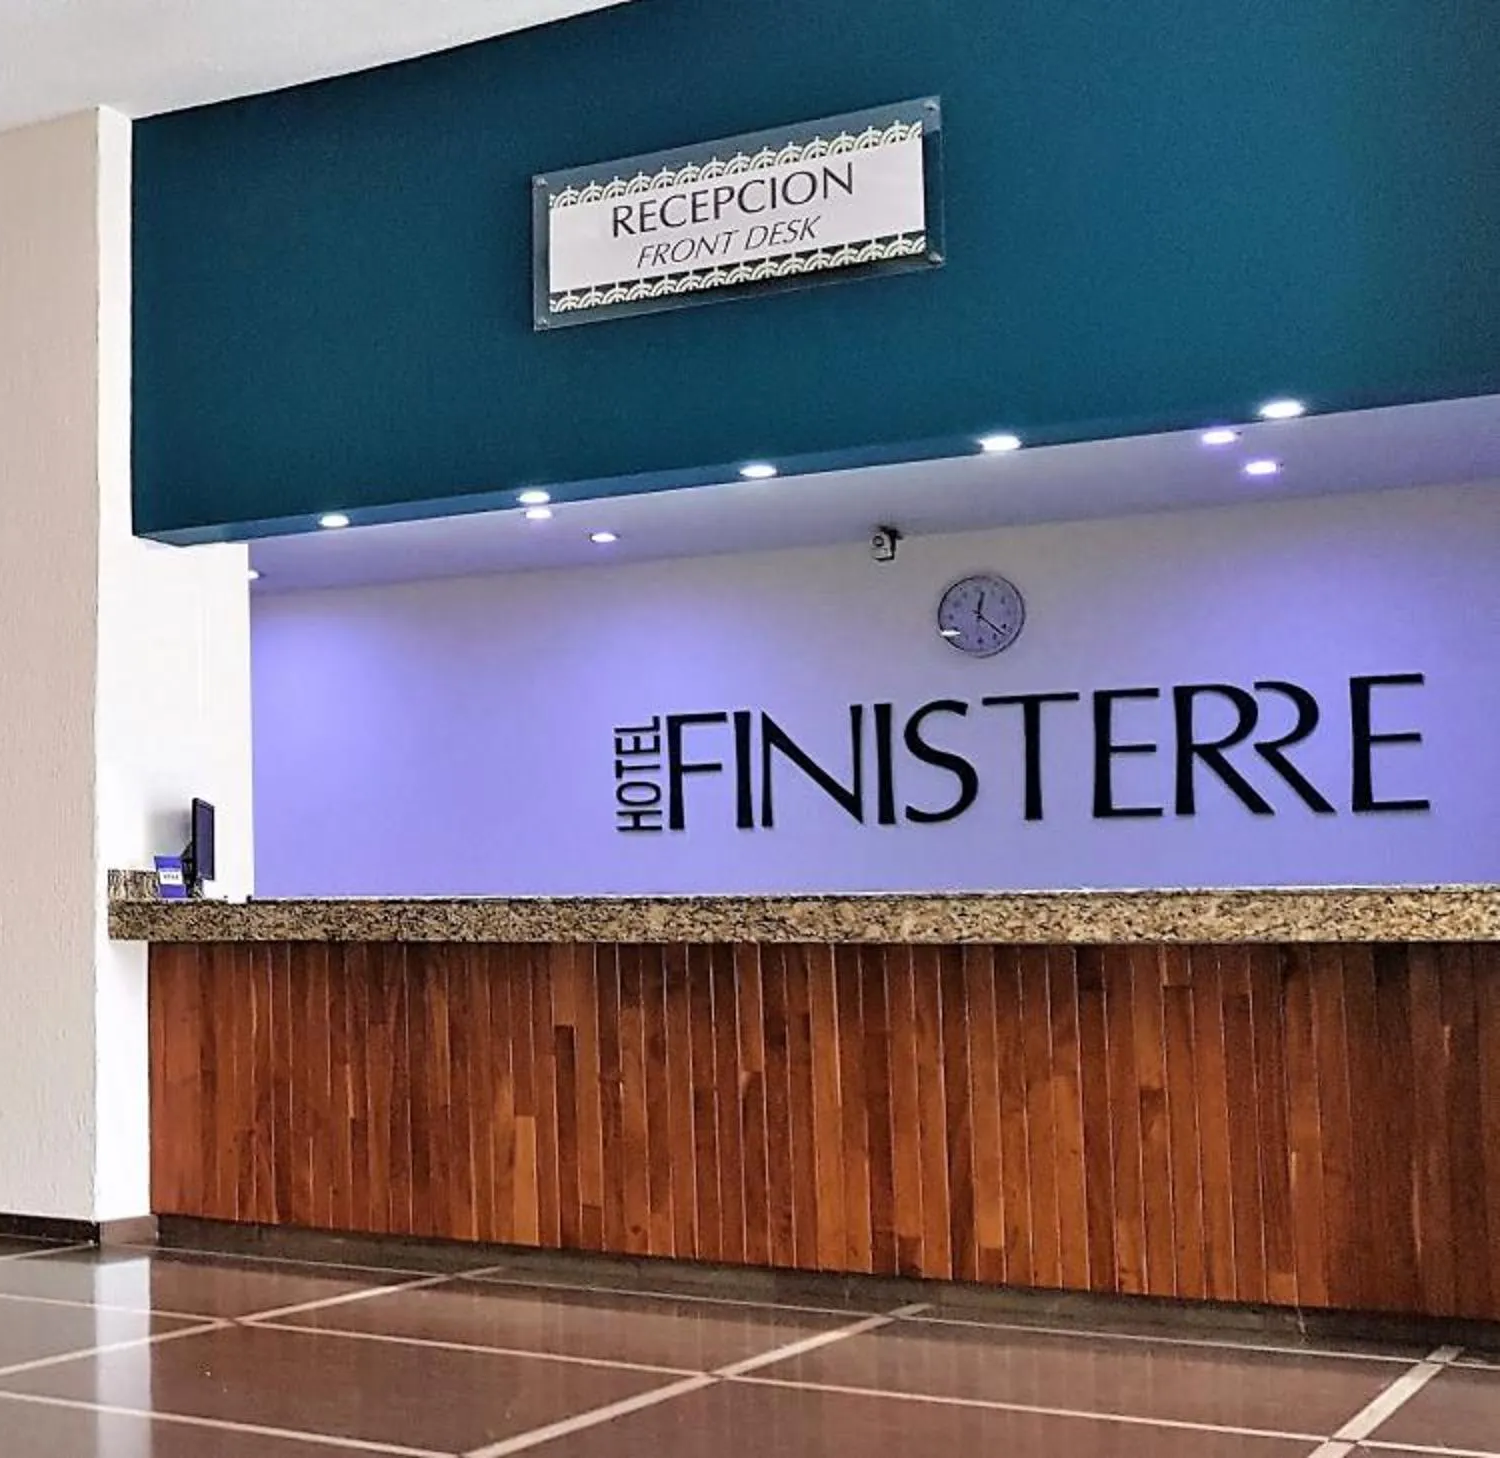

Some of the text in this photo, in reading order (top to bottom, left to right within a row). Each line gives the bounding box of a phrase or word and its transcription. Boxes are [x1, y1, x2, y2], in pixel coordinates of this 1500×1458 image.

[612, 162, 854, 238] RECEPCION
[637, 215, 821, 268] FRONT DESK
[614, 715, 663, 832] HOTEL
[666, 673, 1431, 830] FINISTERRE
